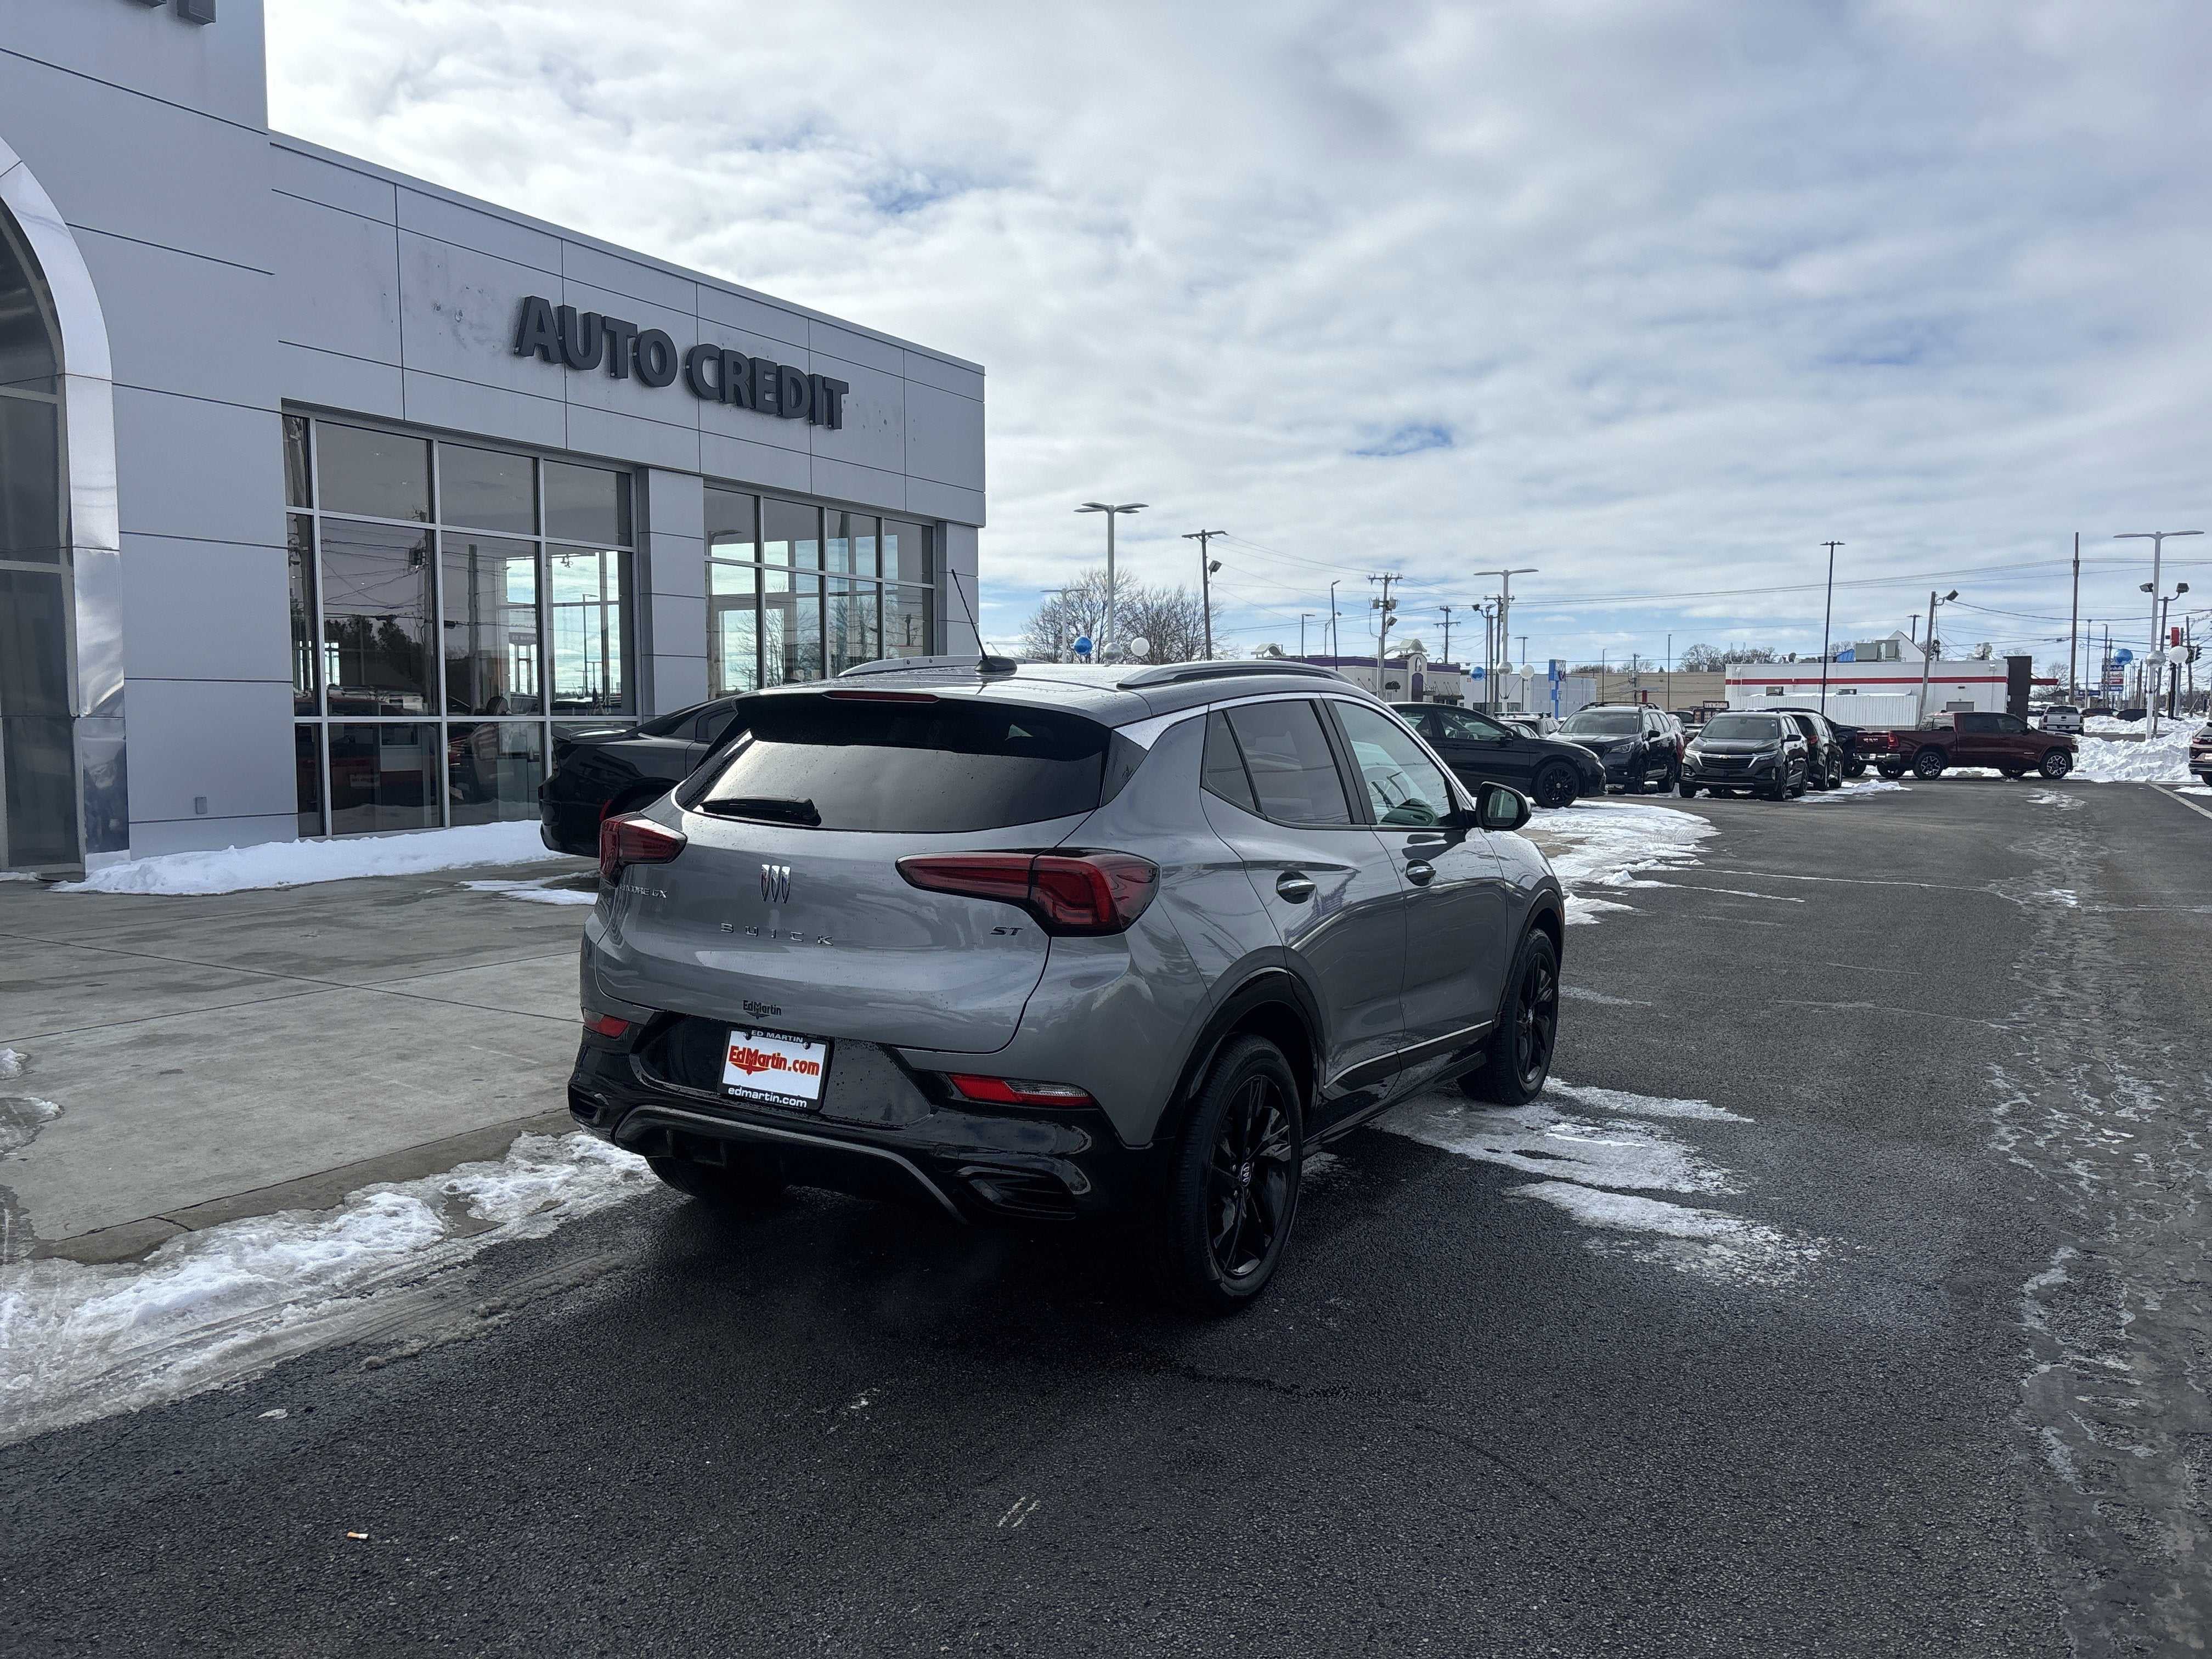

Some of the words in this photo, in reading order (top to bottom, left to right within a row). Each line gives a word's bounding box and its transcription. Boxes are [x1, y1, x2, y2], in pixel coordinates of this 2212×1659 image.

[514, 295, 678, 388] AUTO
[685, 343, 849, 430] CREDIT
[720, 922, 834, 946] BUICK
[990, 926, 1024, 936] ST
[766, 1032, 803, 1043] MARTIN
[729, 1045, 820, 1076] EdMartin.com
[728, 1087, 807, 1108] edmartin.com
